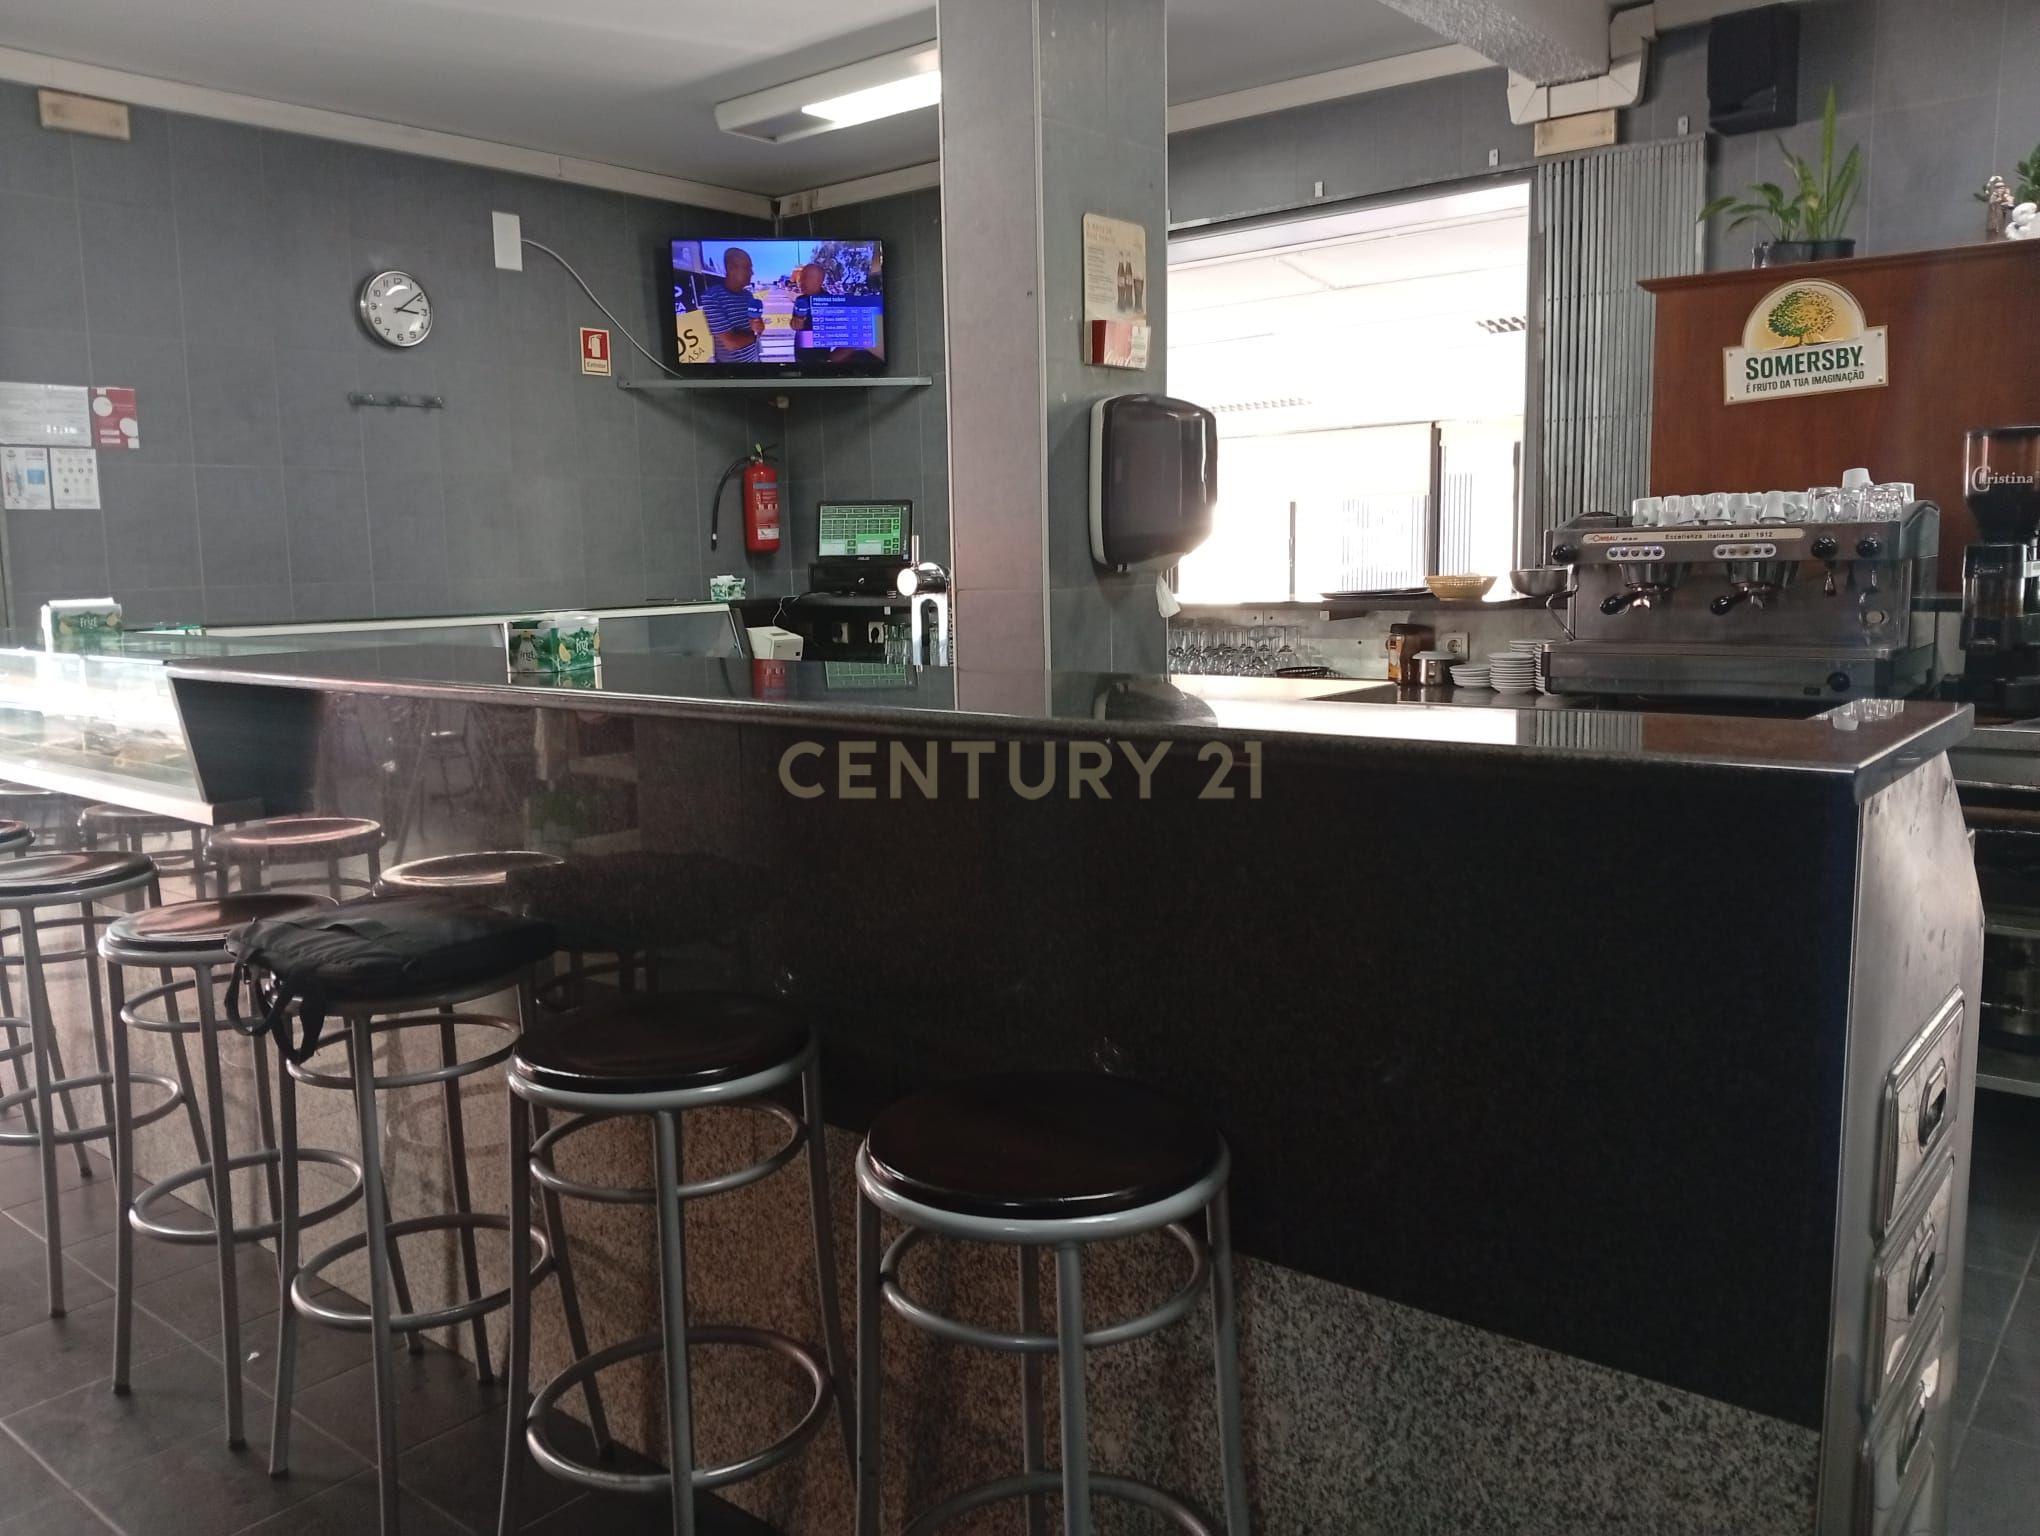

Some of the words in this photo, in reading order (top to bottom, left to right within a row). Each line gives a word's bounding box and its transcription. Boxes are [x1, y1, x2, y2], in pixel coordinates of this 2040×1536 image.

[383, 279, 388, 288] 11
[393, 277, 402, 285] 12
[373, 289, 381, 297] 10
[421, 308, 427, 317] 3
[384, 328, 390, 336] 7
[409, 331, 416, 339] 5
[397, 333, 404, 341] 6
[1746, 382, 1751, 394] É
[1752, 380, 1778, 393] FRUTO
[1779, 379, 1791, 390] DA
[1793, 377, 1810, 387] TUA
[1811, 370, 1865, 384] IMAGINAÇÃO
[1756, 530, 1773, 538] 1912
